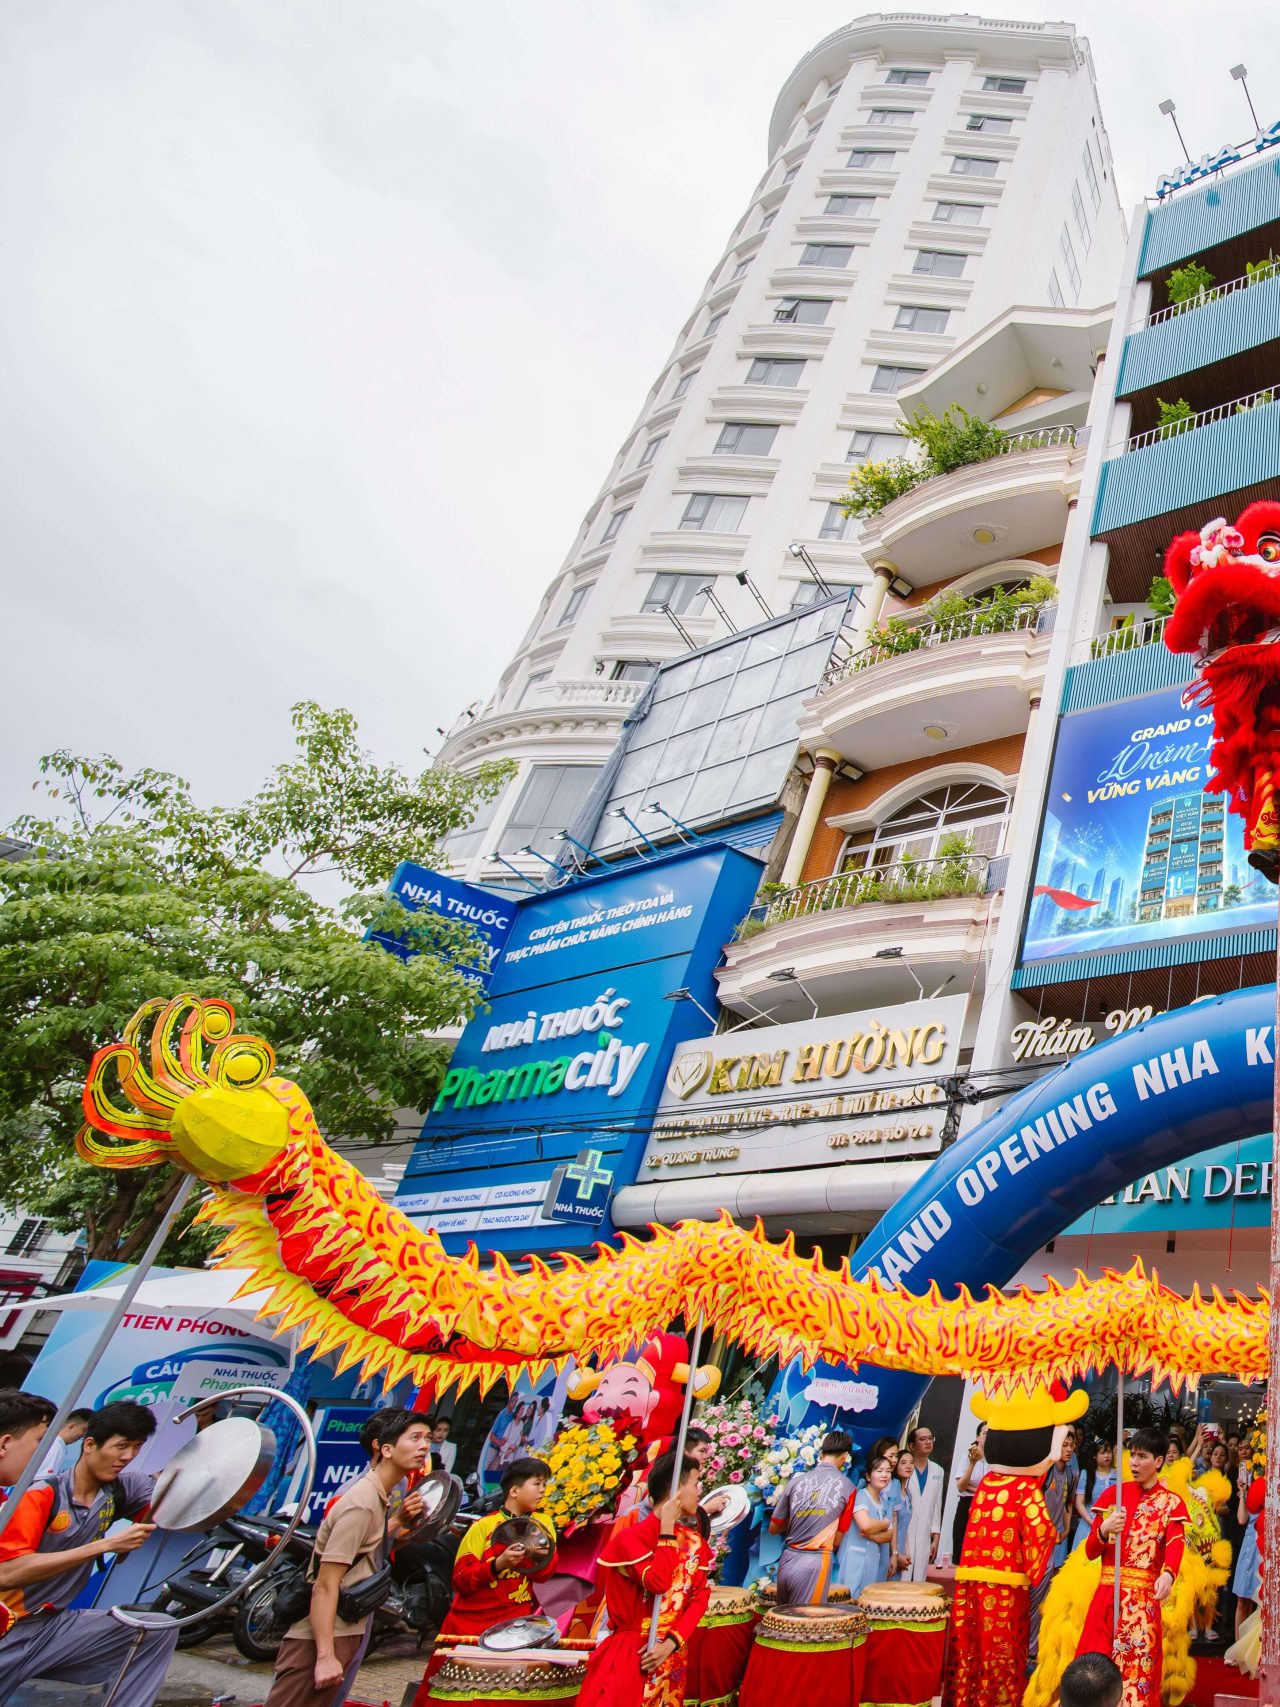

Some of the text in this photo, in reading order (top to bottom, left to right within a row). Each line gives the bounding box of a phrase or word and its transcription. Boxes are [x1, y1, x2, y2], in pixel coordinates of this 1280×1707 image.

[1155, 143, 1241, 197] NHA
[1130, 718, 1192, 743] GRAND
[1087, 773, 1142, 804] VỮNG
[1145, 765, 1201, 793] VÀNG
[400, 881, 510, 930] NHÀ THUỐC
[528, 889, 675, 941] CHUYÊN THUỐC THEO TOA VÀ
[504, 944, 530, 964] THỰC
[529, 935, 560, 956] PHẨM
[559, 926, 590, 949] CHỨC
[588, 921, 622, 943] NĂNG
[621, 912, 660, 935] CHÍNH
[658, 903, 694, 925] HÃNG
[481, 987, 631, 1055] NHÀ THUỐC
[1010, 1015, 1095, 1063] Thẩm
[432, 1031, 650, 1114] Pharmacity
[706, 1018, 947, 1097] KIM HƯỜNG
[850, 1130, 882, 1146] 0914
[955, 1081, 1119, 1208] OPENING
[1130, 1038, 1220, 1102] NHA
[661, 1148, 701, 1167] QUANG
[700, 1146, 740, 1162] TRUNG
[554, 1201, 605, 1218] NHÀ THUỐC
[213, 1366, 280, 1382] NHÀ THUỐC
